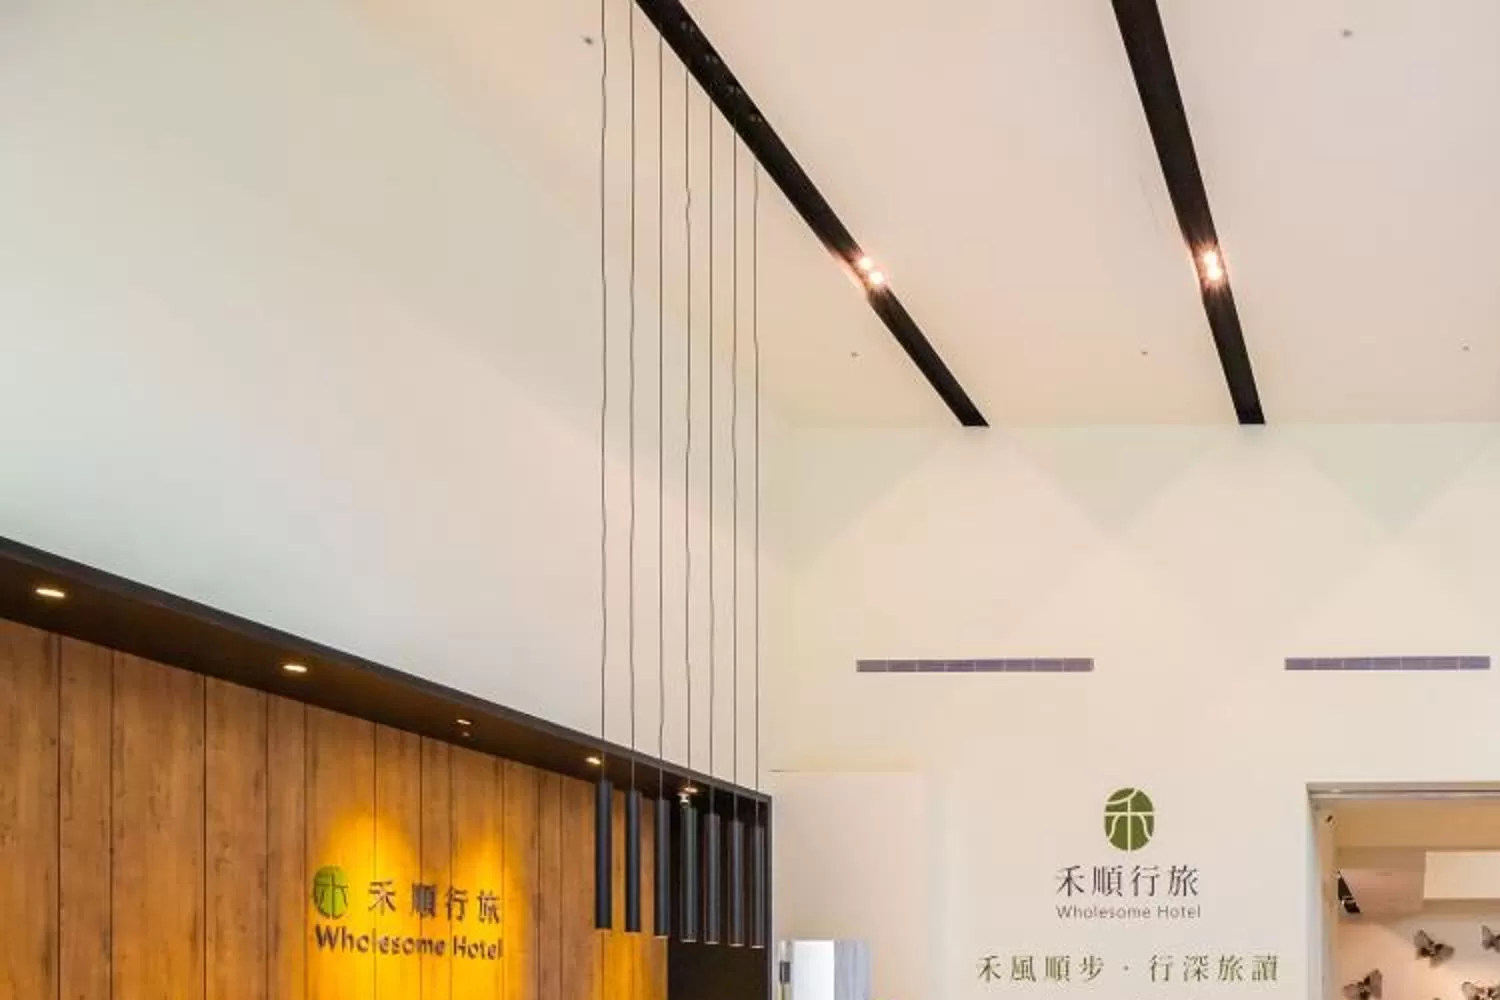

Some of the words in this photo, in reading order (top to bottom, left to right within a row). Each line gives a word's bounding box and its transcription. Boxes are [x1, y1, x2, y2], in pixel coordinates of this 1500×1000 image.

[1056, 865, 1199, 897] 禾順行旅
[368, 880, 501, 924] 禾順行旅
[1056, 905, 1151, 919] Wholesome
[1157, 904, 1201, 919] Hotel
[315, 924, 446, 957] Wholesome
[453, 935, 503, 960] Hotel
